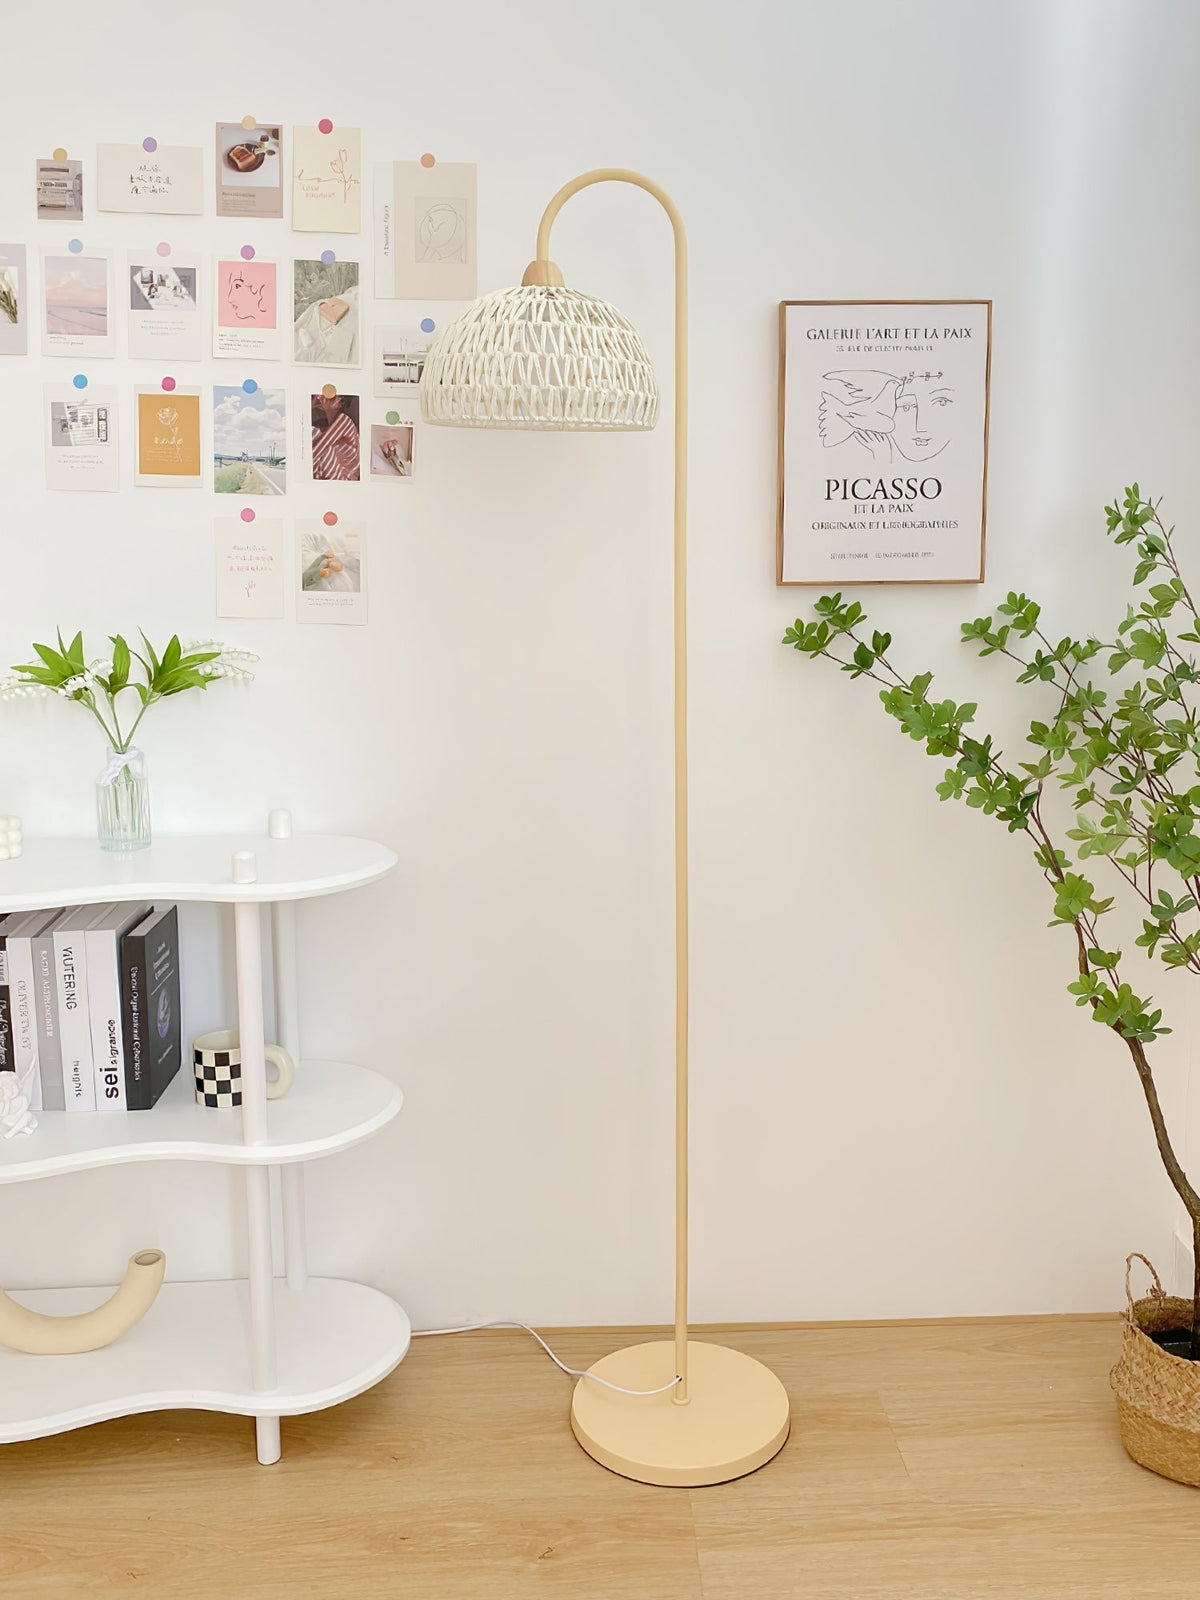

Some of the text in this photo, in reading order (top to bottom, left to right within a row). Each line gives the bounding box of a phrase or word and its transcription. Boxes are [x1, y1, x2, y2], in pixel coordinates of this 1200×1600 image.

[806, 328, 972, 340] GALERIE L'ART ET LA PAIX
[824, 477, 943, 500] PICASSO
[854, 503, 914, 514] ET LA PAIX
[99, 1067, 119, 1099] sei
